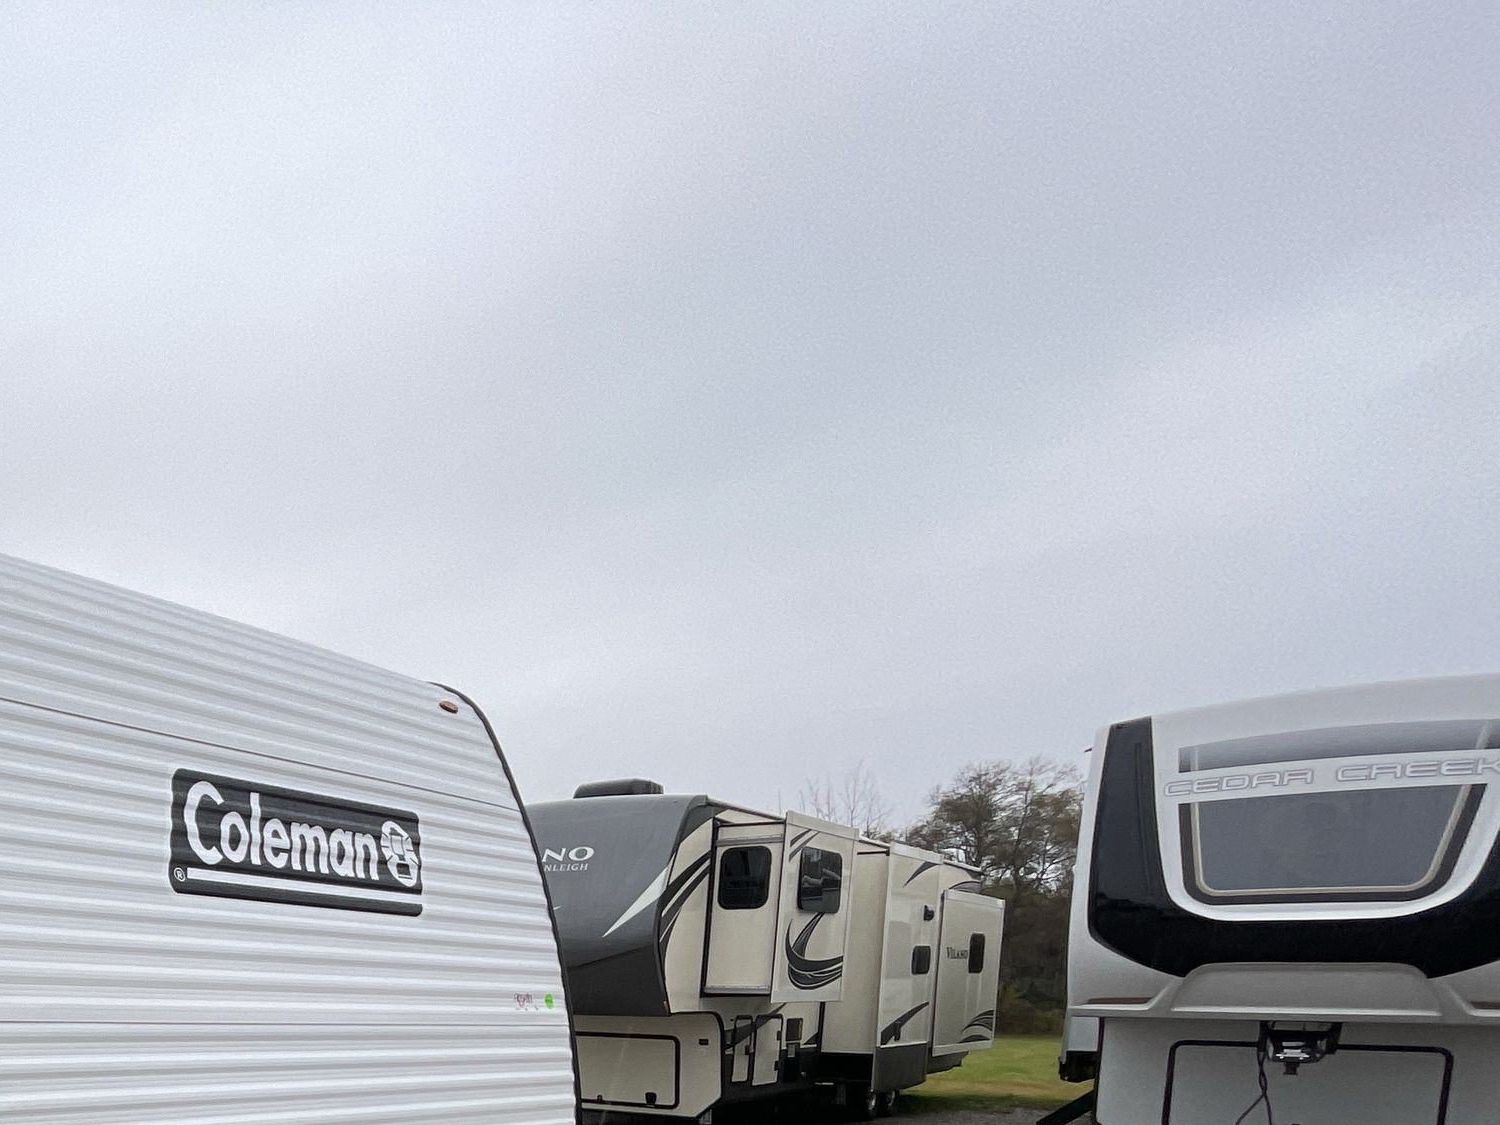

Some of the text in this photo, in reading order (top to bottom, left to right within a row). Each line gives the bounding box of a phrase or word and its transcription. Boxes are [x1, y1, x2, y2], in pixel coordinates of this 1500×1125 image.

[1164, 768, 1314, 797] CEDAR
[183, 780, 380, 881] Coleman
[541, 846, 595, 863] NO
[543, 863, 589, 872] NLEIGH
